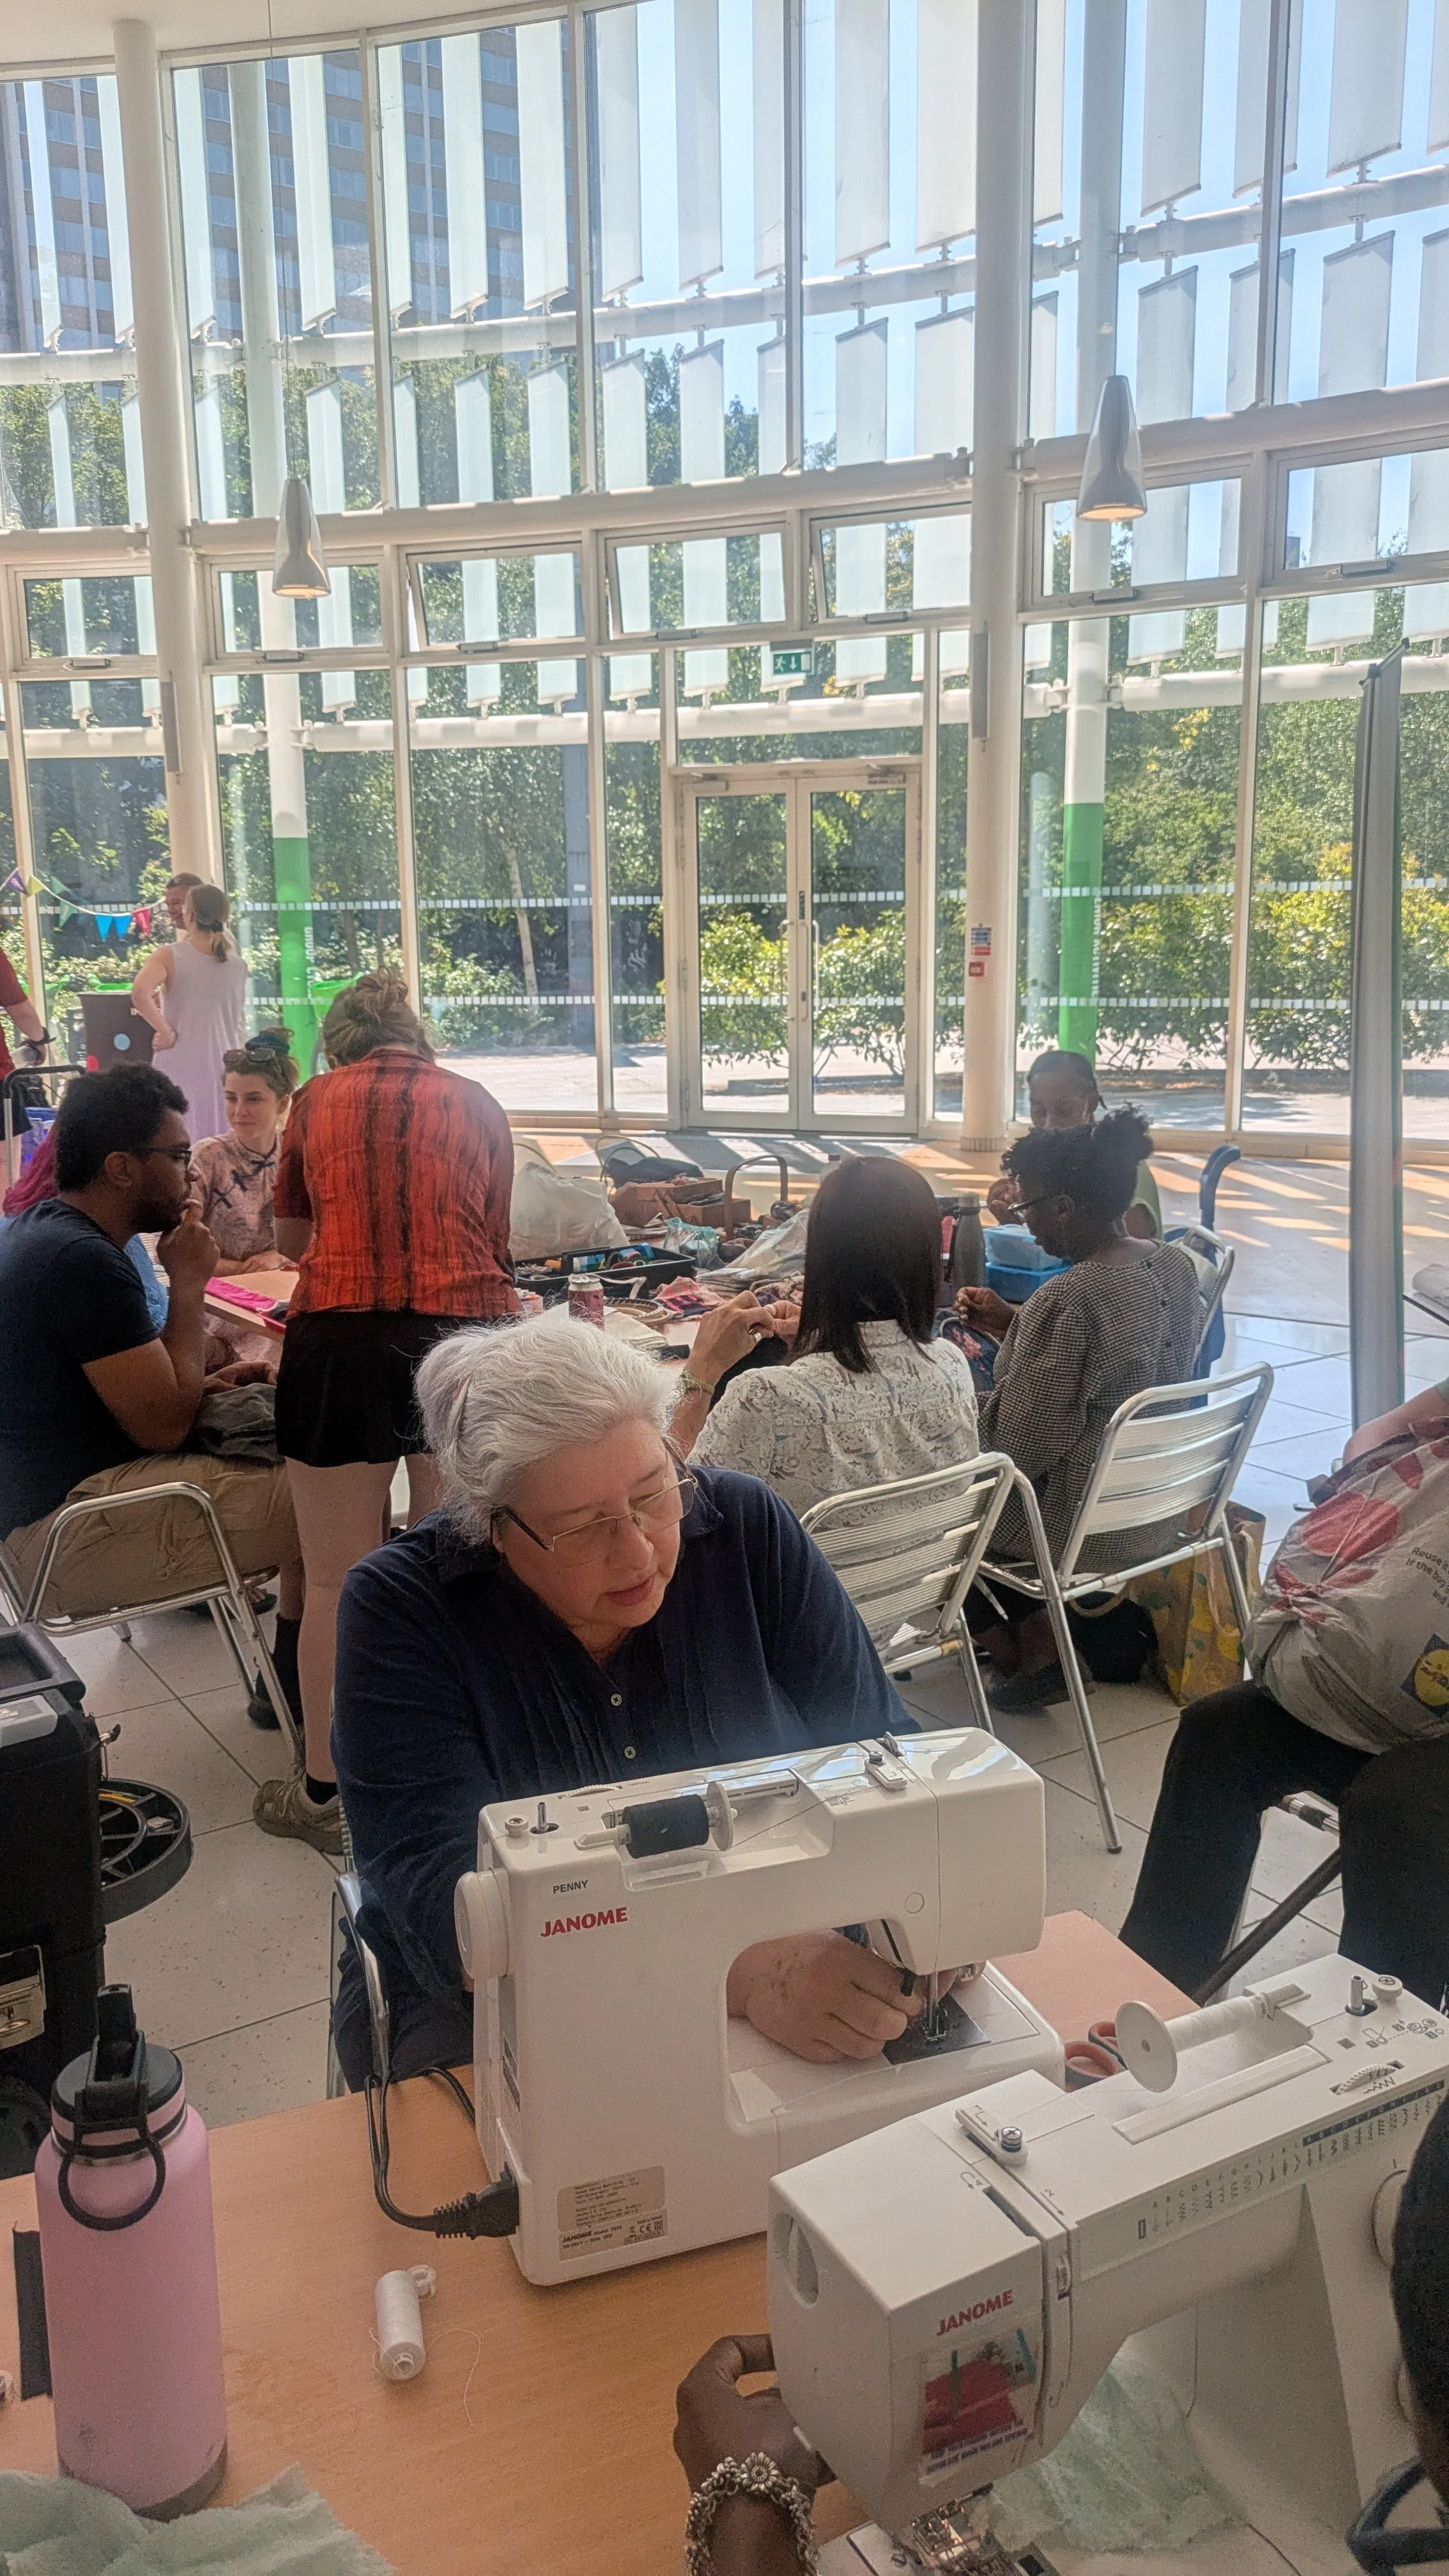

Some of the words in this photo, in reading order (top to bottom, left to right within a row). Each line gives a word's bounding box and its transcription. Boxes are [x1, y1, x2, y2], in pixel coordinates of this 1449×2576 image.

[1411, 1547, 1443, 1567] Reuse
[1416, 1561, 1432, 1575] the
[553, 1879, 588, 1894] PENNY
[540, 1906, 628, 1937] JANOME
[1044, 2189, 1055, 2197] 2
[562, 2230, 592, 2242] JANOME
[936, 2288, 1014, 2336] JANOME
